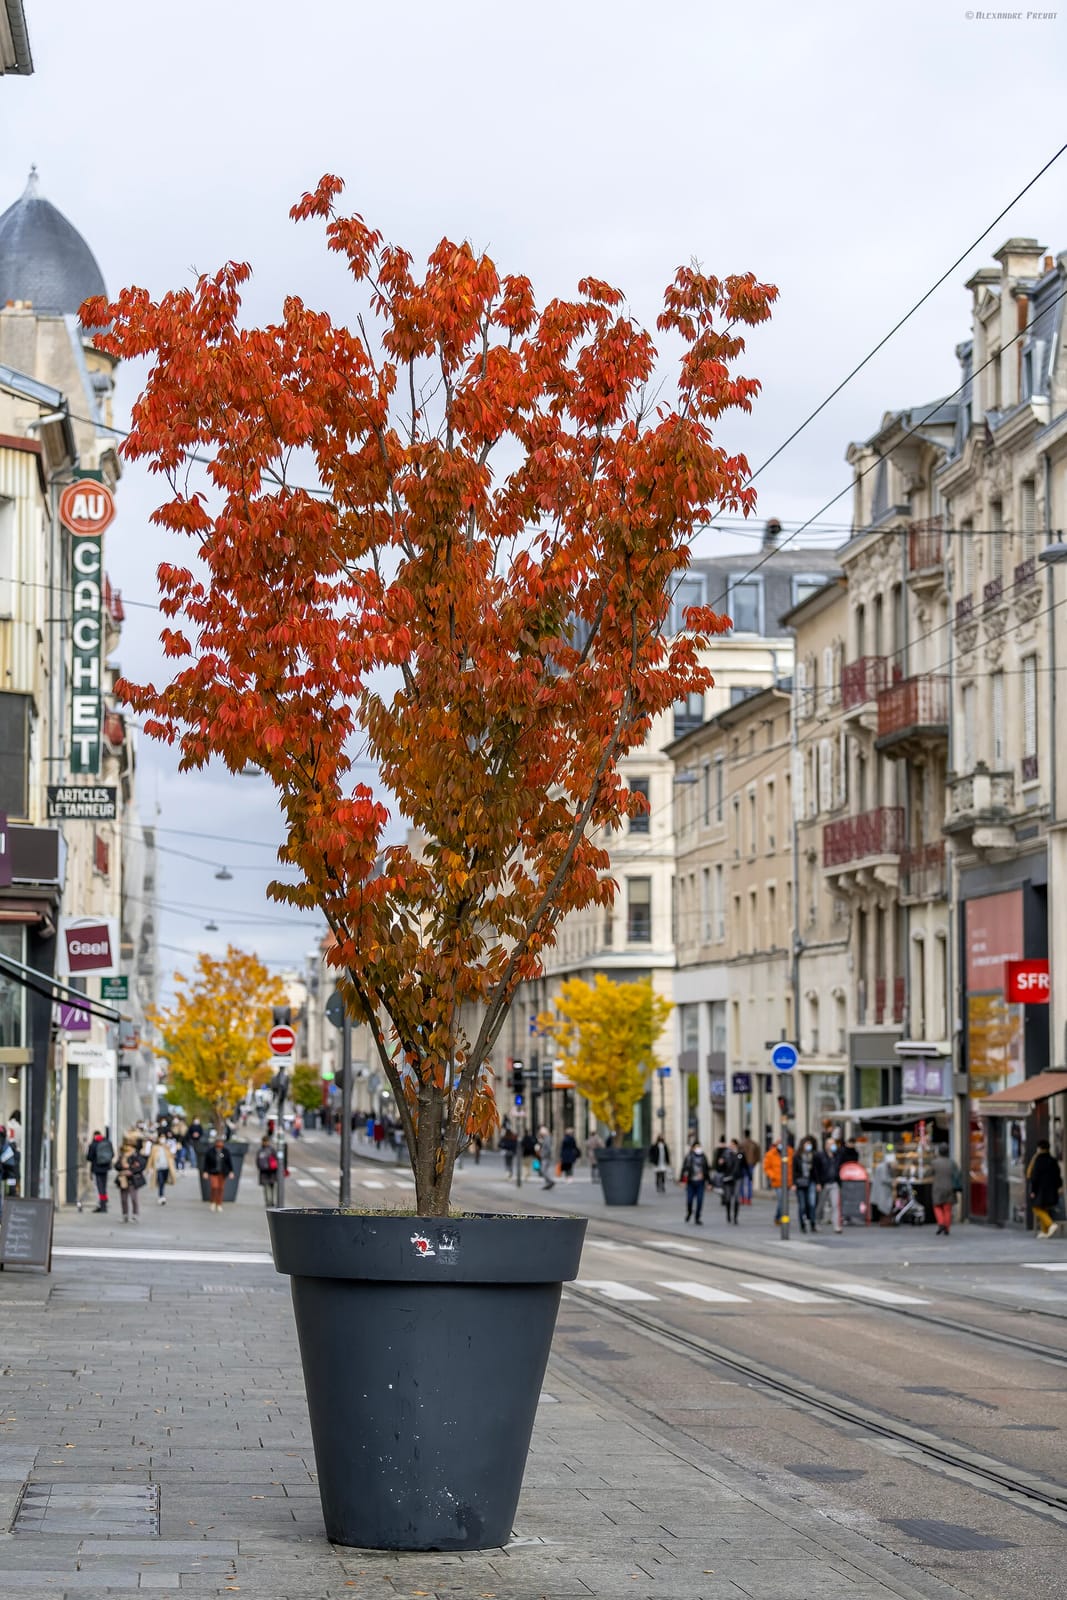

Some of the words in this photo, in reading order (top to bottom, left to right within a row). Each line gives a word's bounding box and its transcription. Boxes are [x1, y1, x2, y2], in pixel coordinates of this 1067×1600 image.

[72, 495, 104, 520] AU
[73, 541, 101, 765] CACHET
[56, 788, 109, 802] ARTICLES
[1017, 972, 1049, 989] SFR
